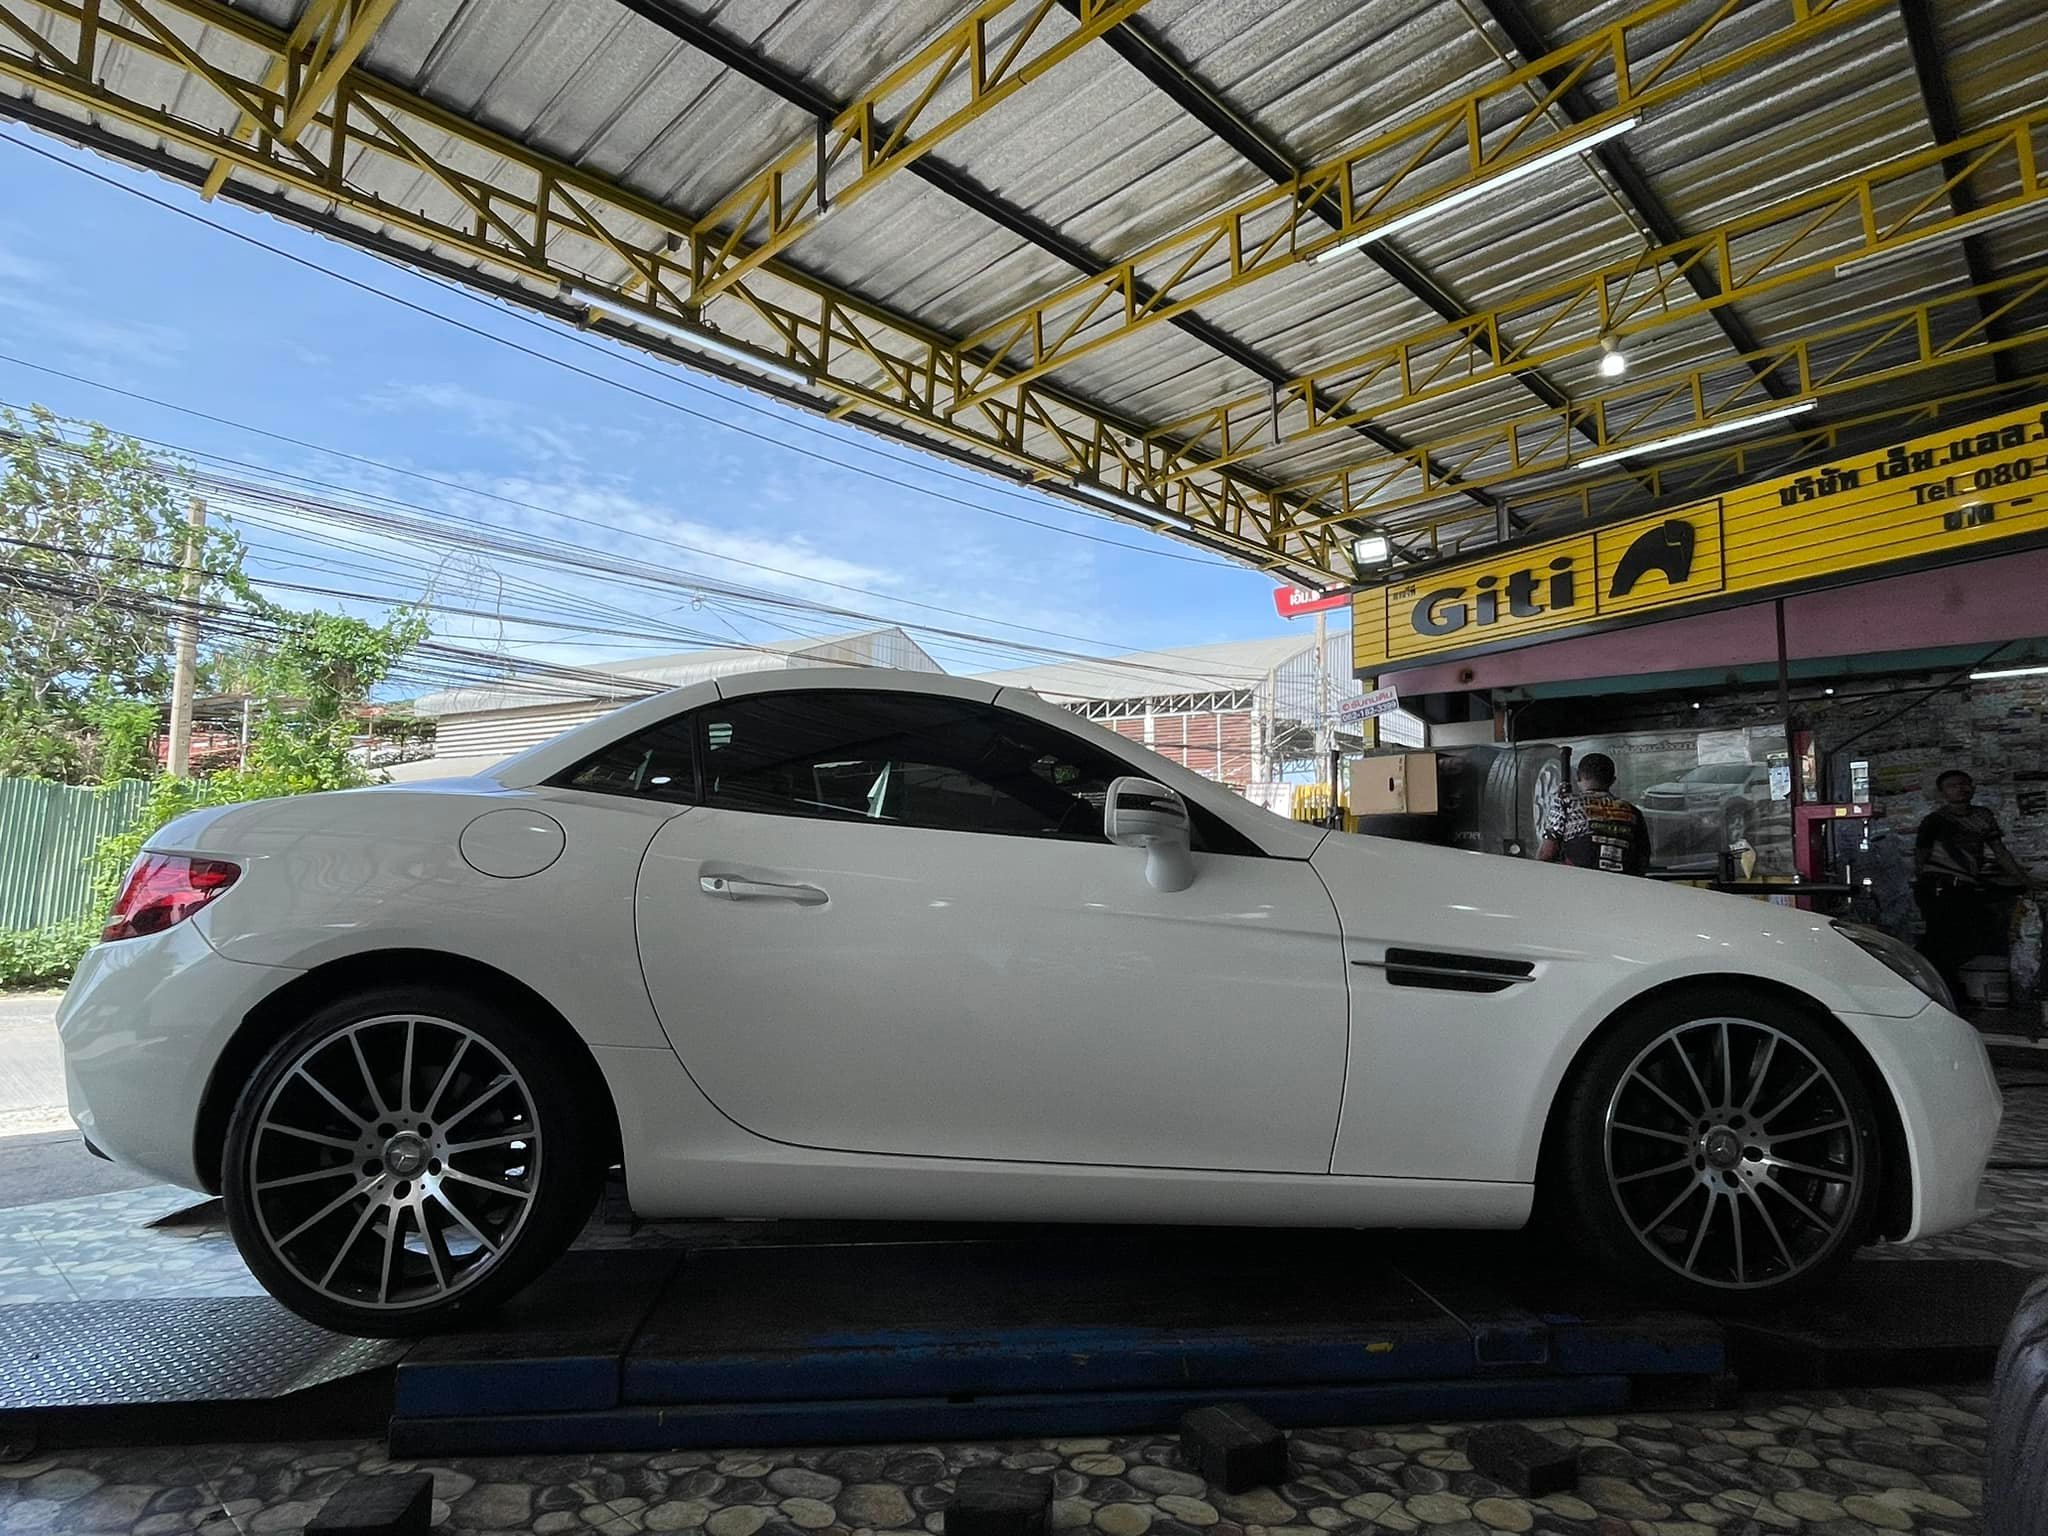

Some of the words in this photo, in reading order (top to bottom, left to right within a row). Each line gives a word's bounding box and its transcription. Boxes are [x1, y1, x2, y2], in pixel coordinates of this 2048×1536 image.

[1779, 468, 1859, 506] บริษัท
[1973, 457, 2048, 490] 080-
[1411, 557, 1574, 636] Giti
